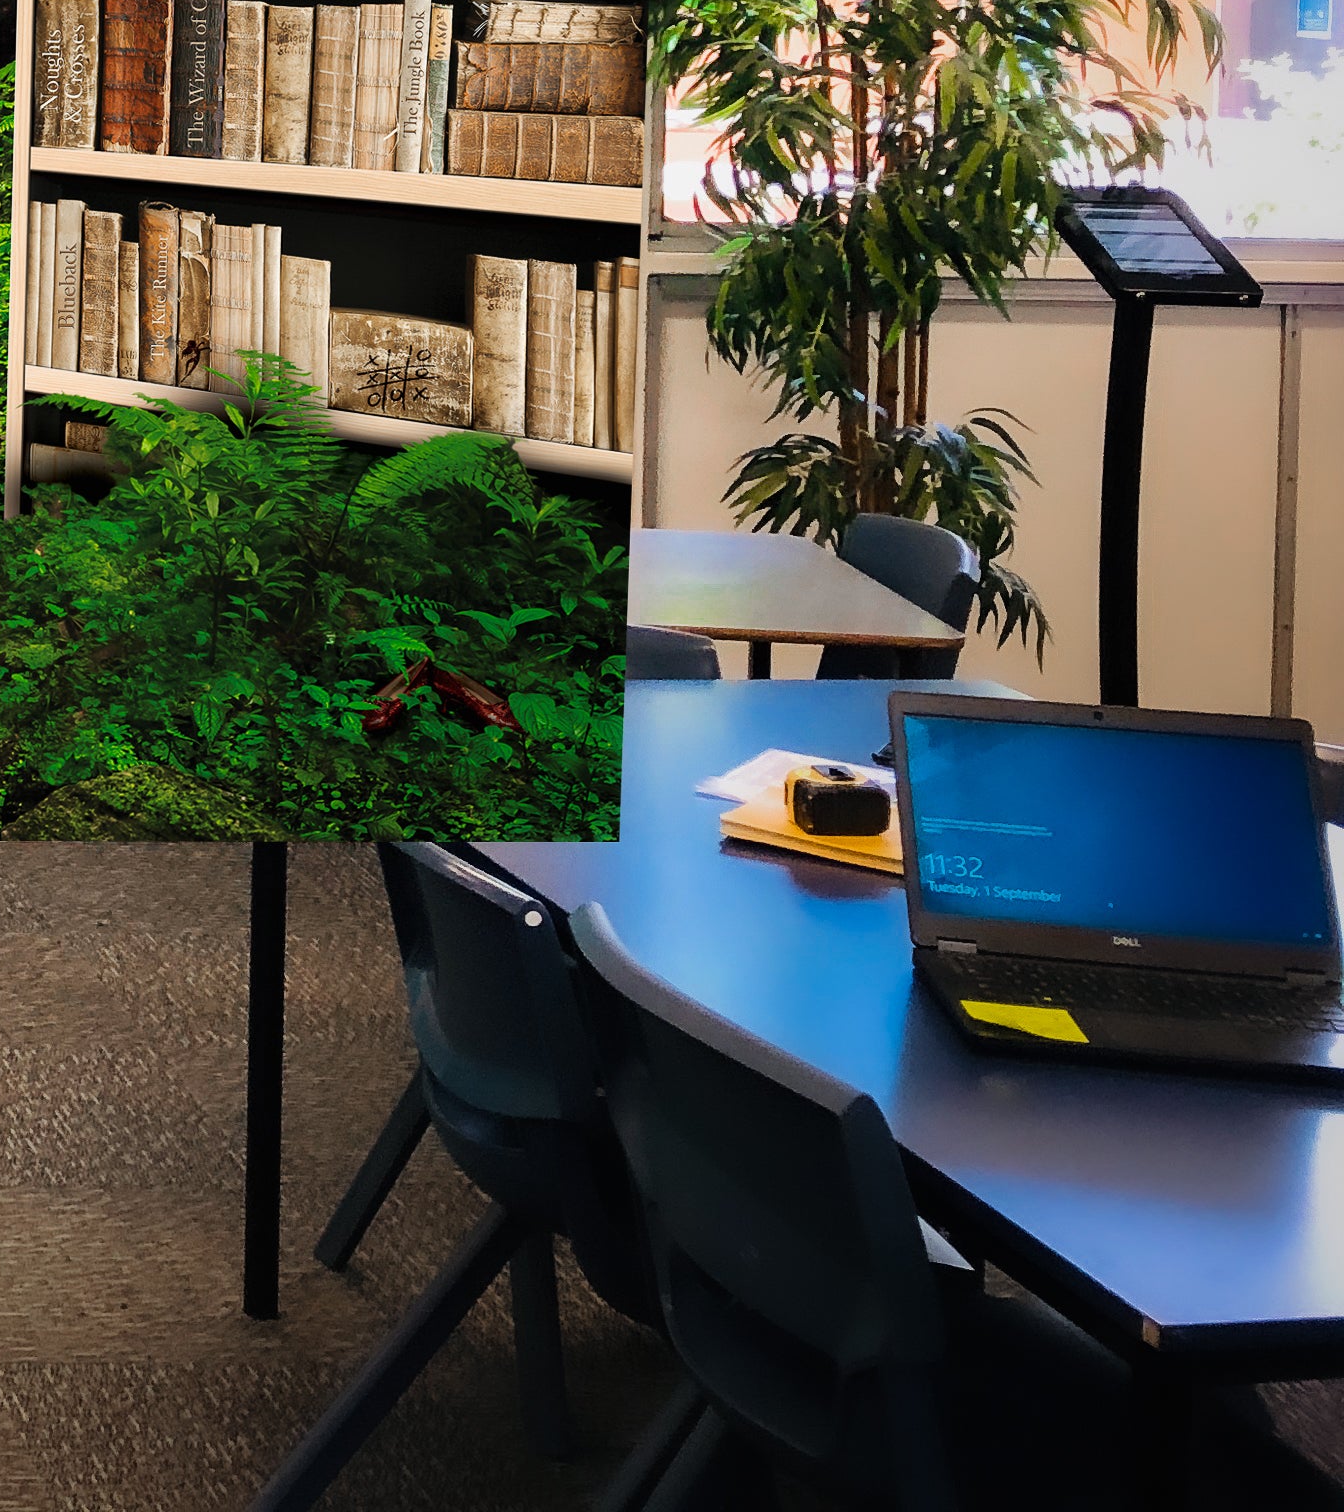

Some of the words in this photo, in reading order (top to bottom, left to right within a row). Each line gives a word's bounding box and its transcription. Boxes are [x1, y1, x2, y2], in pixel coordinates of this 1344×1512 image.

[190, 15, 207, 36] of
[409, 10, 426, 52] Book
[39, 29, 64, 112] Noughts
[64, 24, 85, 99] Crosses
[188, 40, 207, 106] Wizard
[406, 56, 424, 106] Jungle
[64, 107, 83, 123] &
[187, 111, 204, 148] The
[403, 107, 418, 138] The
[153, 235, 169, 290] Runner
[58, 243, 77, 329] Blueback
[152, 295, 167, 325] Kite
[150, 329, 165, 362] The
[924, 853, 984, 879] 11:32
[928, 880, 980, 898] Tuesday,
[994, 886, 1061, 903] September
[1113, 936, 1142, 948] DELL
